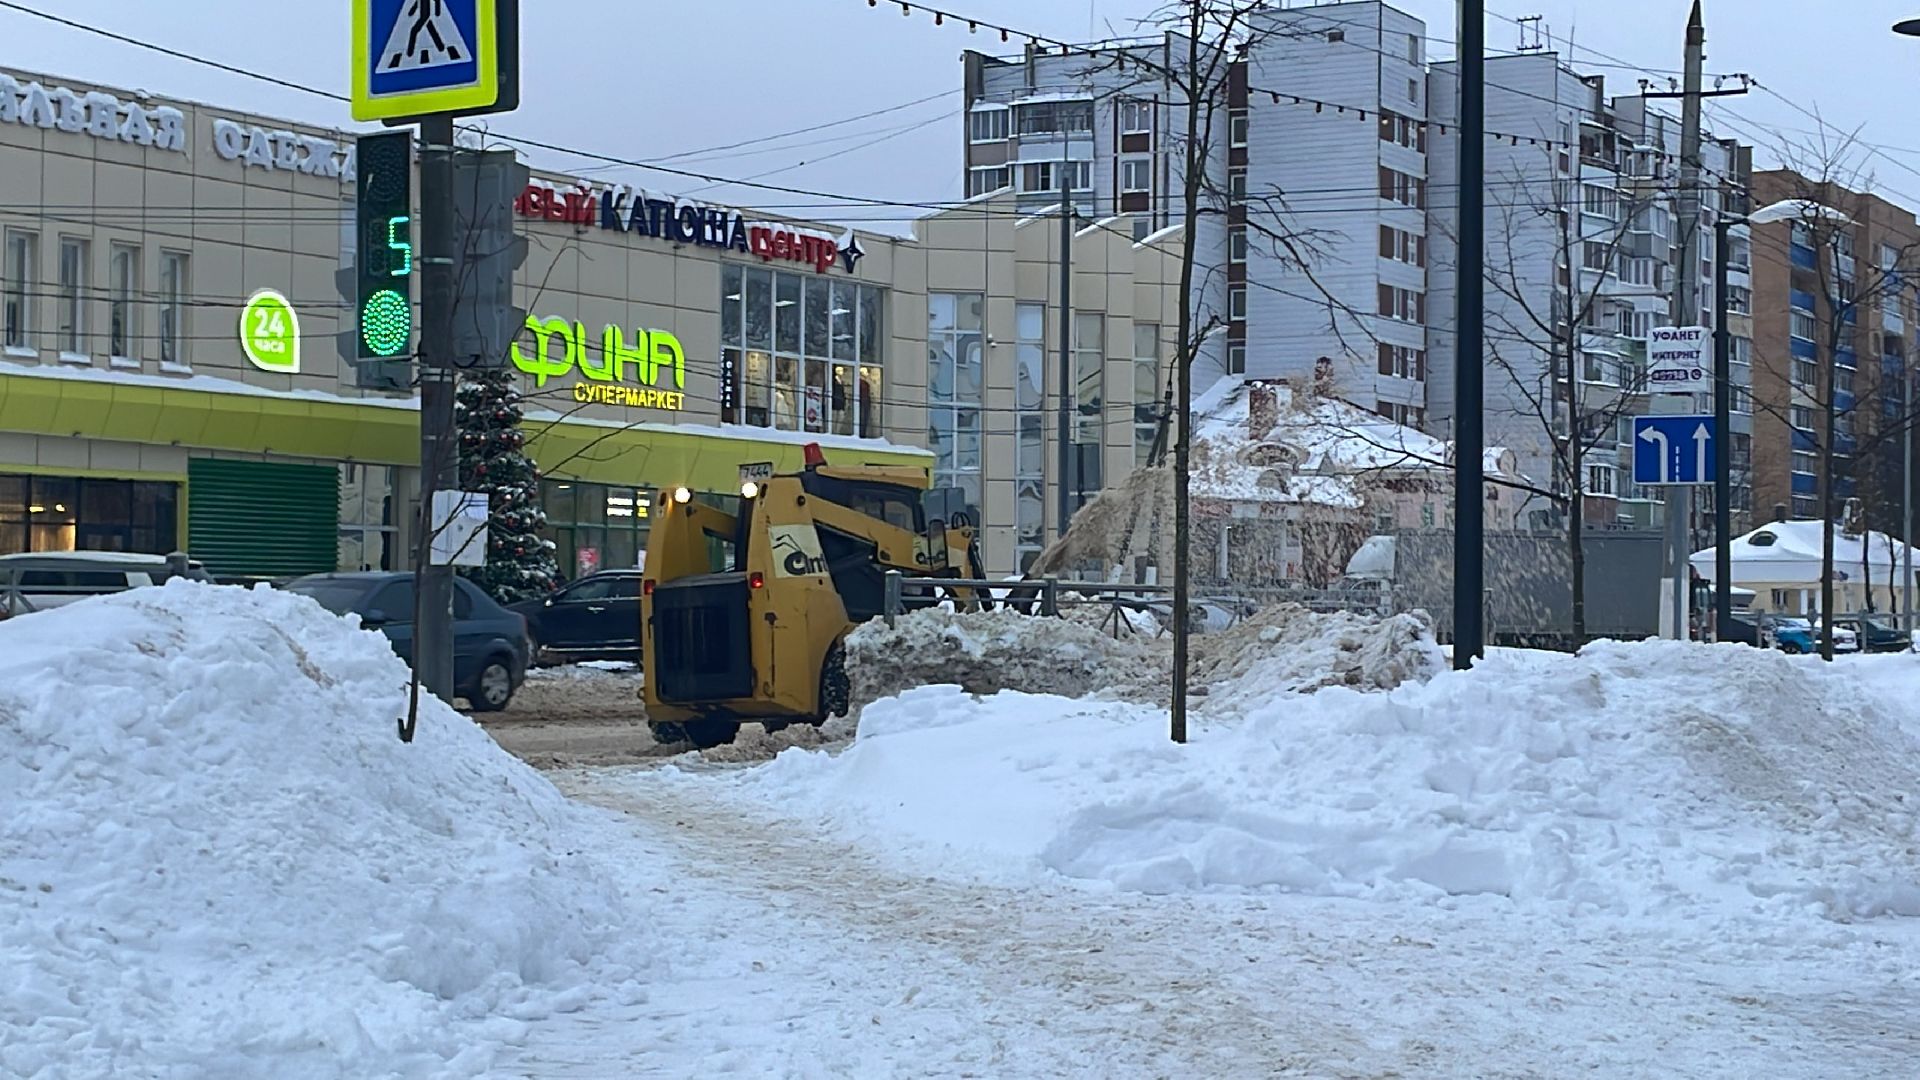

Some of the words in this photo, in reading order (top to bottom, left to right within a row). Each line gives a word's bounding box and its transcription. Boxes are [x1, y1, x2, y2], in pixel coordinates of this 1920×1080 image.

[389, 216, 412, 276] 5
[254, 308, 285, 338] 24
[1653, 330, 1701, 342] УФАНЕТ
[1652, 350, 1701, 360] ИНТЕРНЕТ
[574, 382, 685, 411] СУПЕРМАРКЕТ
